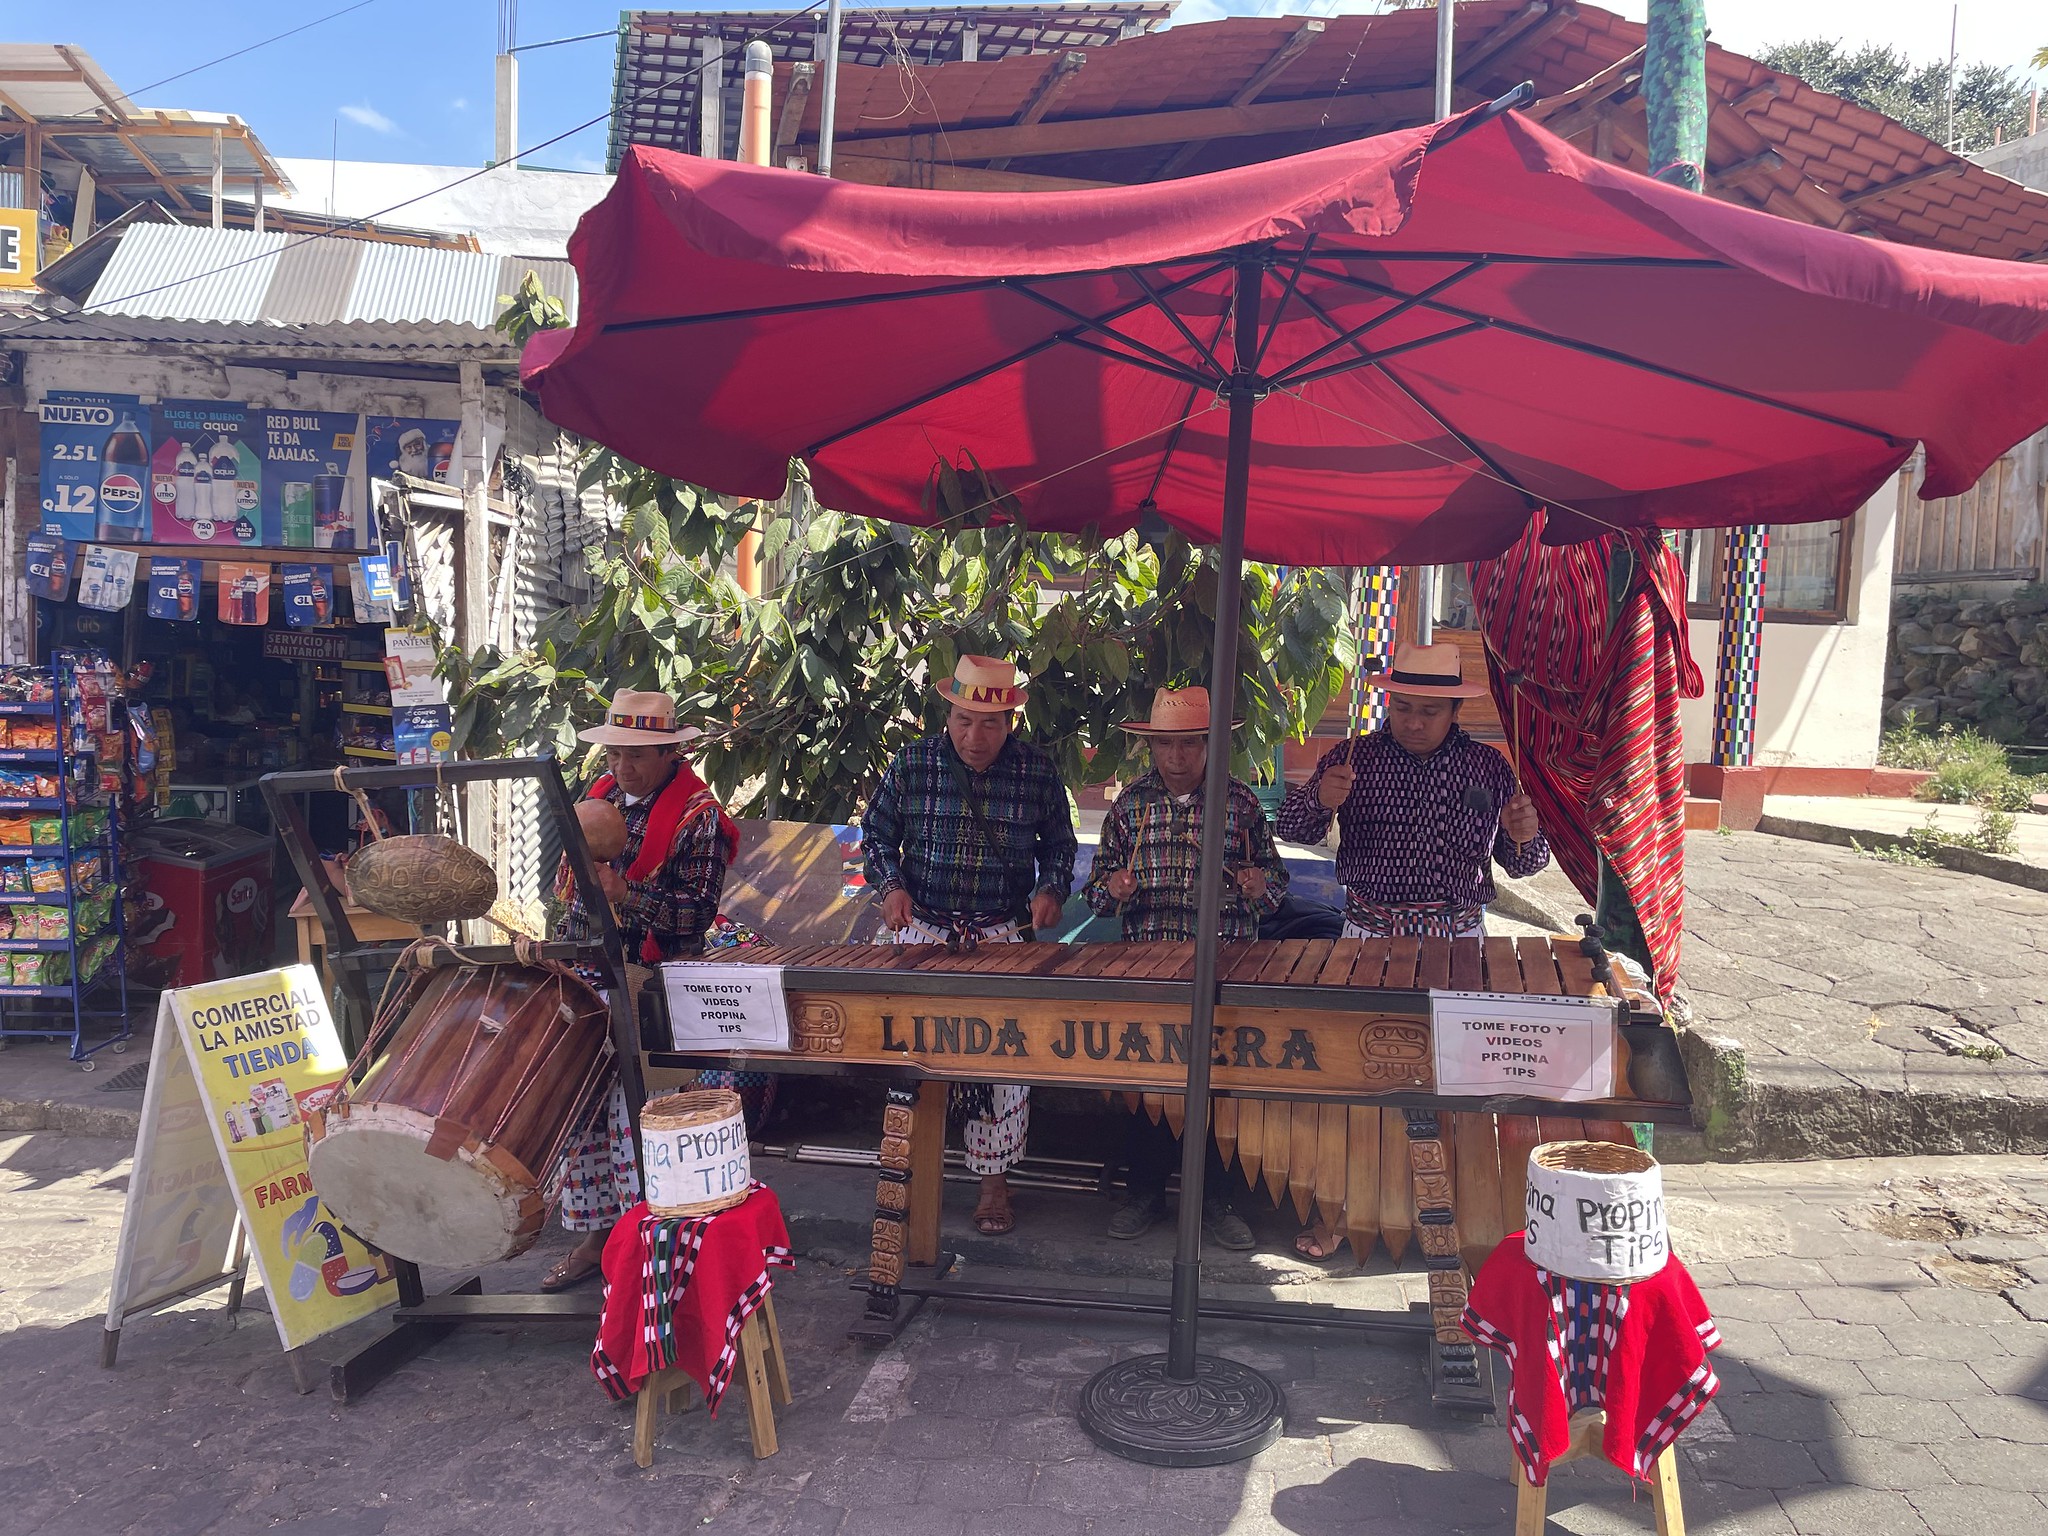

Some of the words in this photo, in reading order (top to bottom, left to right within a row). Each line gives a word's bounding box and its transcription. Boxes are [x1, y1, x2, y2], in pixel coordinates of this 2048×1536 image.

[44, 407, 109, 423] NUEVO
[164, 410, 191, 419] ELIGE
[194, 411, 206, 420] LO
[209, 412, 246, 422] BUENO,
[173, 420, 200, 430] ELIGE
[203, 421, 238, 432] aqua
[266, 415, 289, 430] RED
[293, 416, 320, 431] BULL
[266, 431, 280, 445] TE
[283, 432, 301, 446] DA
[267, 447, 320, 462] AAALAS.
[103, 487, 140, 499] PEPSI
[244, 490, 251, 498] 3
[33, 565, 46, 575] 3L
[162, 589, 174, 597] 3L
[297, 596, 309, 604] 3L
[268, 634, 323, 647] SERVICIO
[392, 638, 431, 647] PANTENE
[266, 645, 325, 657] SANITARIO
[231, 885, 252, 906] Sarita
[683, 985, 712, 993] TOME
[715, 985, 742, 993] FOTO
[744, 985, 752, 993] Y
[192, 988, 316, 1029] COMERCIAL
[702, 998, 740, 1007] VIDEOS
[700, 1011, 746, 1020] PROPINA
[199, 1031, 228, 1052] LA
[234, 1009, 320, 1045] AMISTAD
[718, 1024, 742, 1033] TIPS
[1462, 1022, 1505, 1031] TOME
[1510, 1023, 1551, 1034] FOTO
[1556, 1026, 1566, 1035] Y
[880, 1015, 1029, 1057] LINDA
[1050, 1019, 1322, 1072] JUANERA
[1486, 1036, 1543, 1048] VIDEOS
[222, 1037, 319, 1079] TIENDA
[1481, 1052, 1549, 1064] PROPINA
[1502, 1067, 1536, 1078] TIPS
